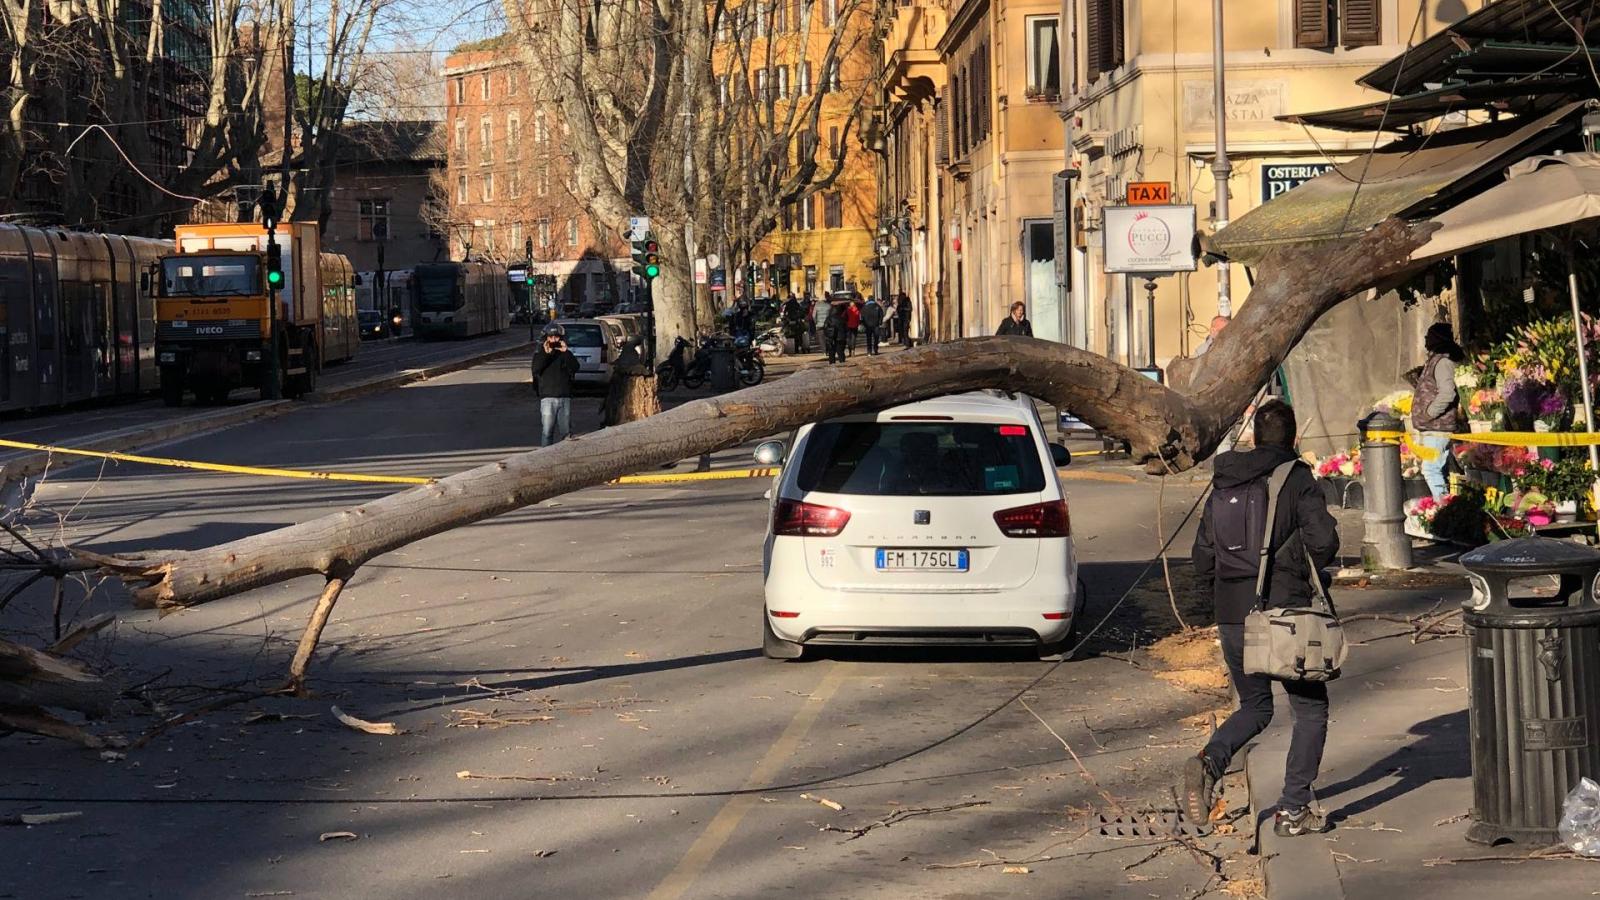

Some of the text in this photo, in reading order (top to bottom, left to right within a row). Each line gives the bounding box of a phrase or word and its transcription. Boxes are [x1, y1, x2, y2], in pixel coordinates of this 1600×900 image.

[1212, 94, 1259, 105] AZZA
[1130, 187, 1167, 201] TAXI
[1132, 232, 1167, 242] PUCCI
[196, 326, 222, 334] IVECO
[886, 552, 905, 567] FM
[912, 552, 957, 567] 175GL
